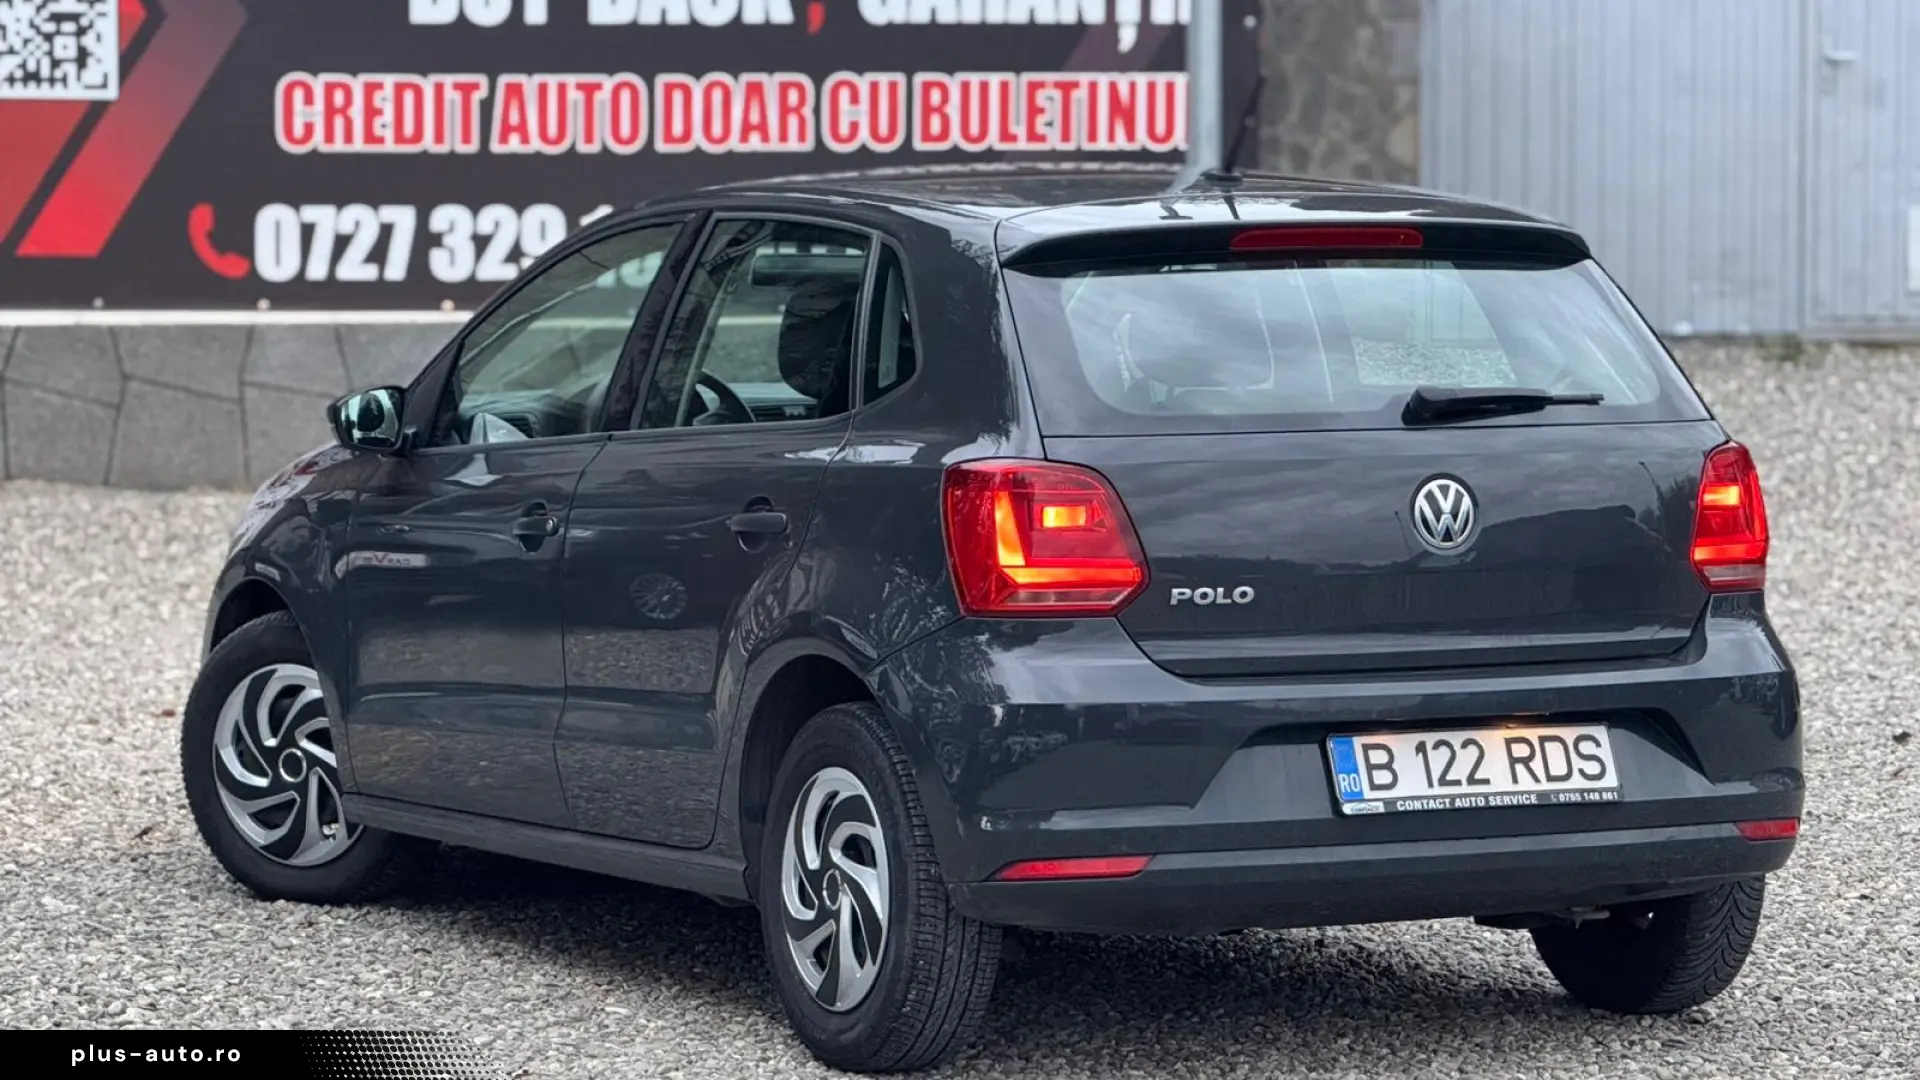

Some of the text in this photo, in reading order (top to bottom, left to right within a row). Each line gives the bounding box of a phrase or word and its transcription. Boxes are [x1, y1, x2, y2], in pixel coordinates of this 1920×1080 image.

[279, 75, 1188, 150] CREDIT AUTO DOAR CU BULETINU
[254, 204, 416, 283] 0727
[428, 204, 567, 283] 329
[1169, 586, 1255, 605] POLO
[1361, 734, 1606, 791] B 122 RDS
[1340, 773, 1360, 793] RO
[1397, 799, 1451, 811] CONTACT
[1455, 796, 1485, 809] AUTO
[1488, 794, 1538, 806] SERVICE
